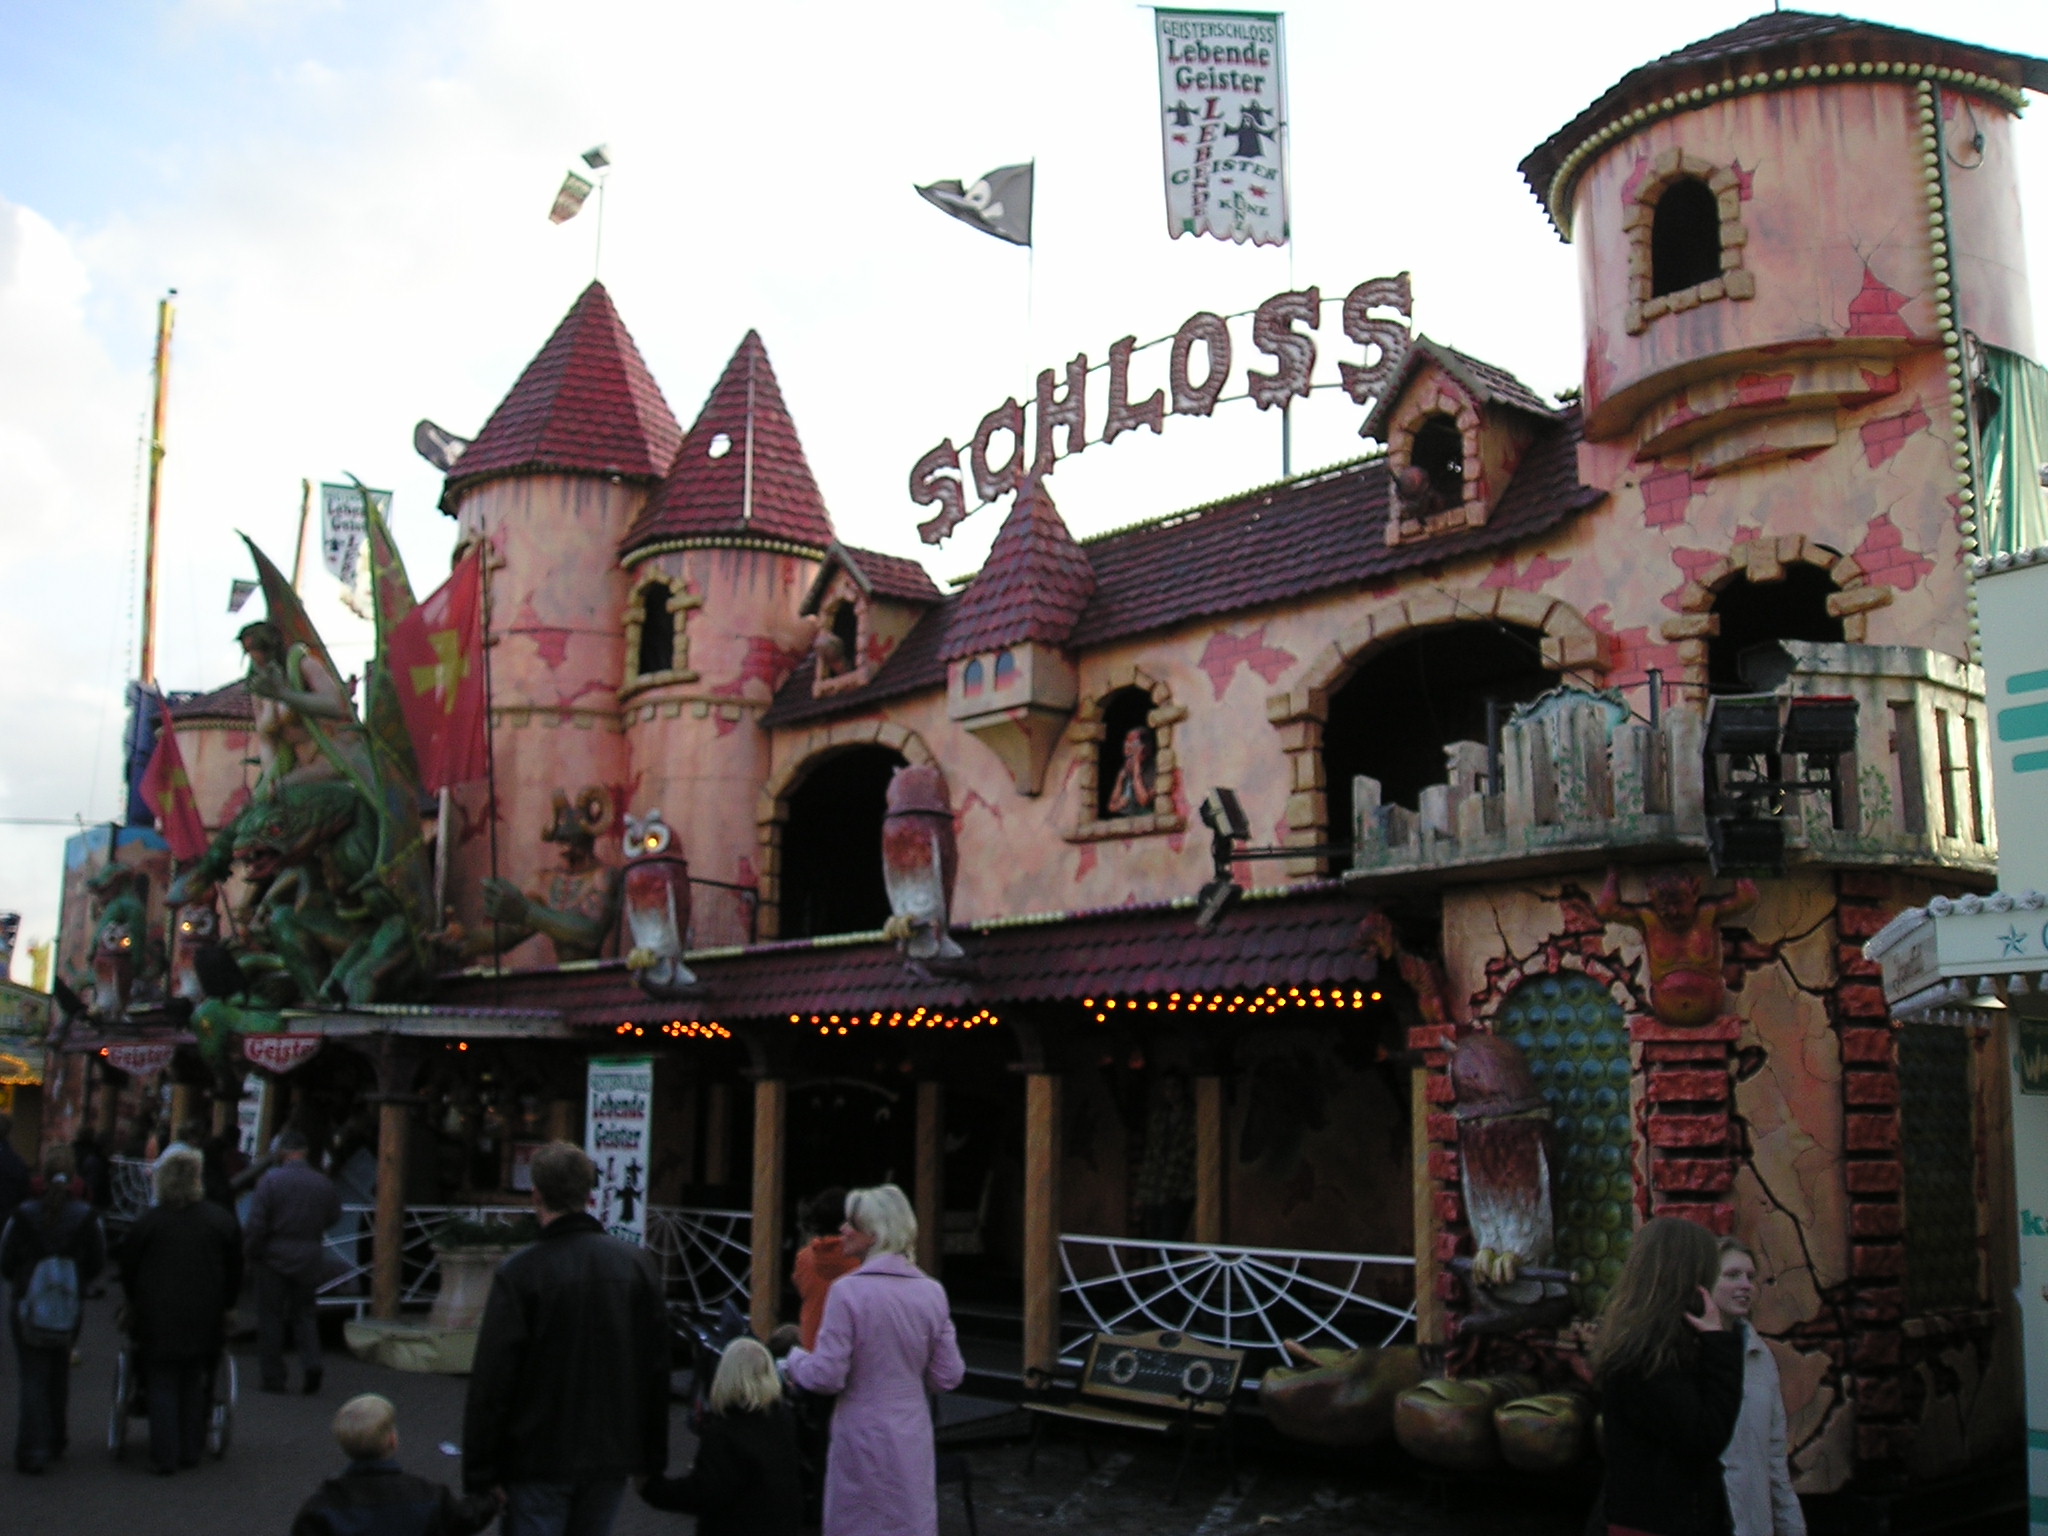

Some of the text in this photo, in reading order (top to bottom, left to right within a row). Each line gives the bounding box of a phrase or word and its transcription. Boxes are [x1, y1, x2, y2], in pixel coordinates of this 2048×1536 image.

[1162, 19, 1275, 43] GEISTERSCHLOSS
[1167, 38, 1270, 66] Lebende
[1175, 66, 1266, 93] Geister
[909, 271, 1413, 546] SCHLOSS
